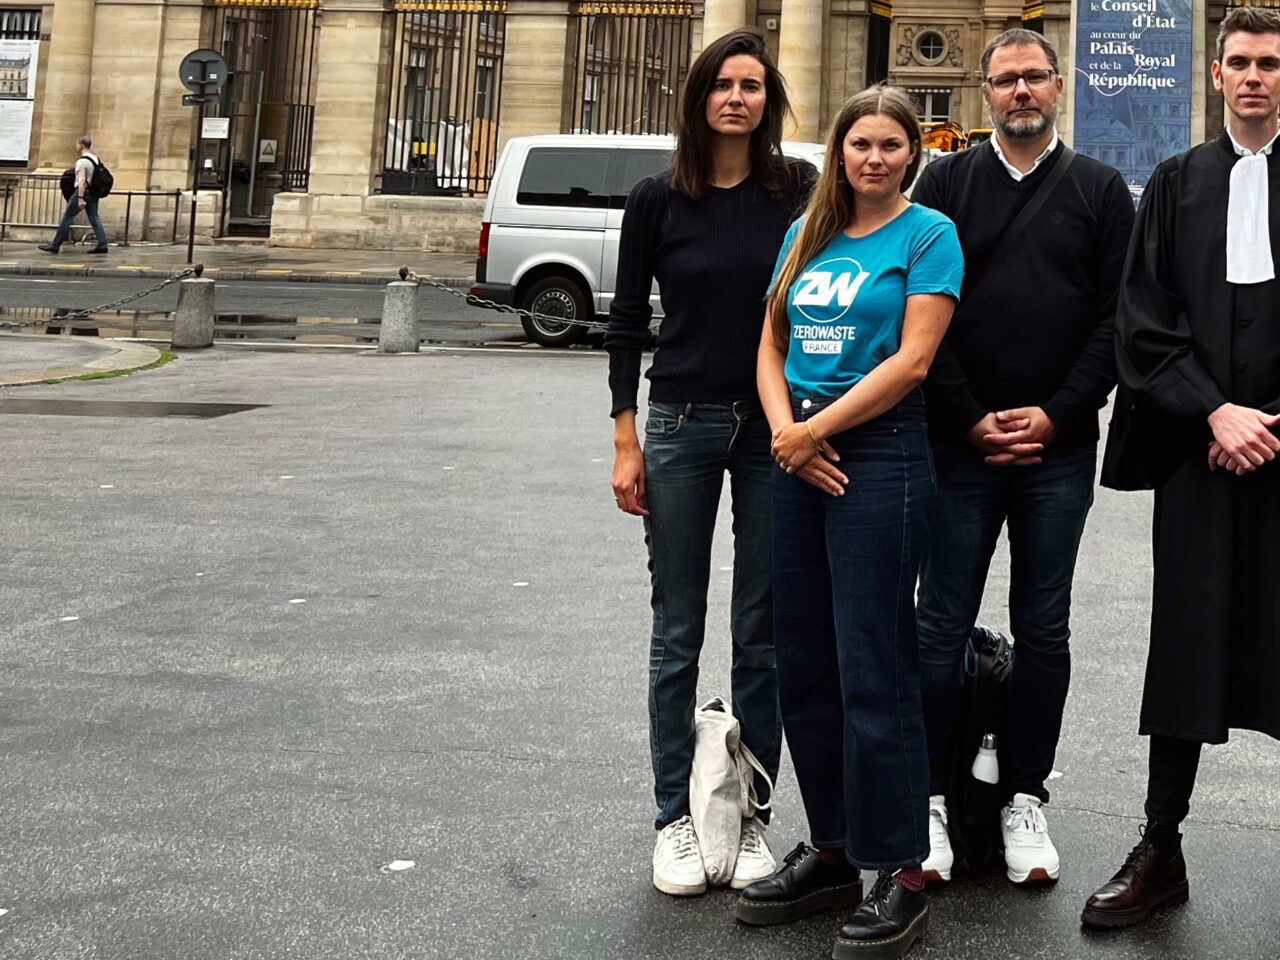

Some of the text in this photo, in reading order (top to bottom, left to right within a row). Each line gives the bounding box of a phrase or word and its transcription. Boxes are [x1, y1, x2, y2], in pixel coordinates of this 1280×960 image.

[1090, 0, 1157, 12] le Conseil
[1090, 31, 1101, 39] au
[1129, 30, 1141, 39] du
[1089, 61, 1121, 70] et de la
[1135, 53, 1175, 69] Royal
[1089, 73, 1176, 90] République
[793, 325, 856, 340] ZEROWASTE
[804, 342, 839, 352] FRANCE
